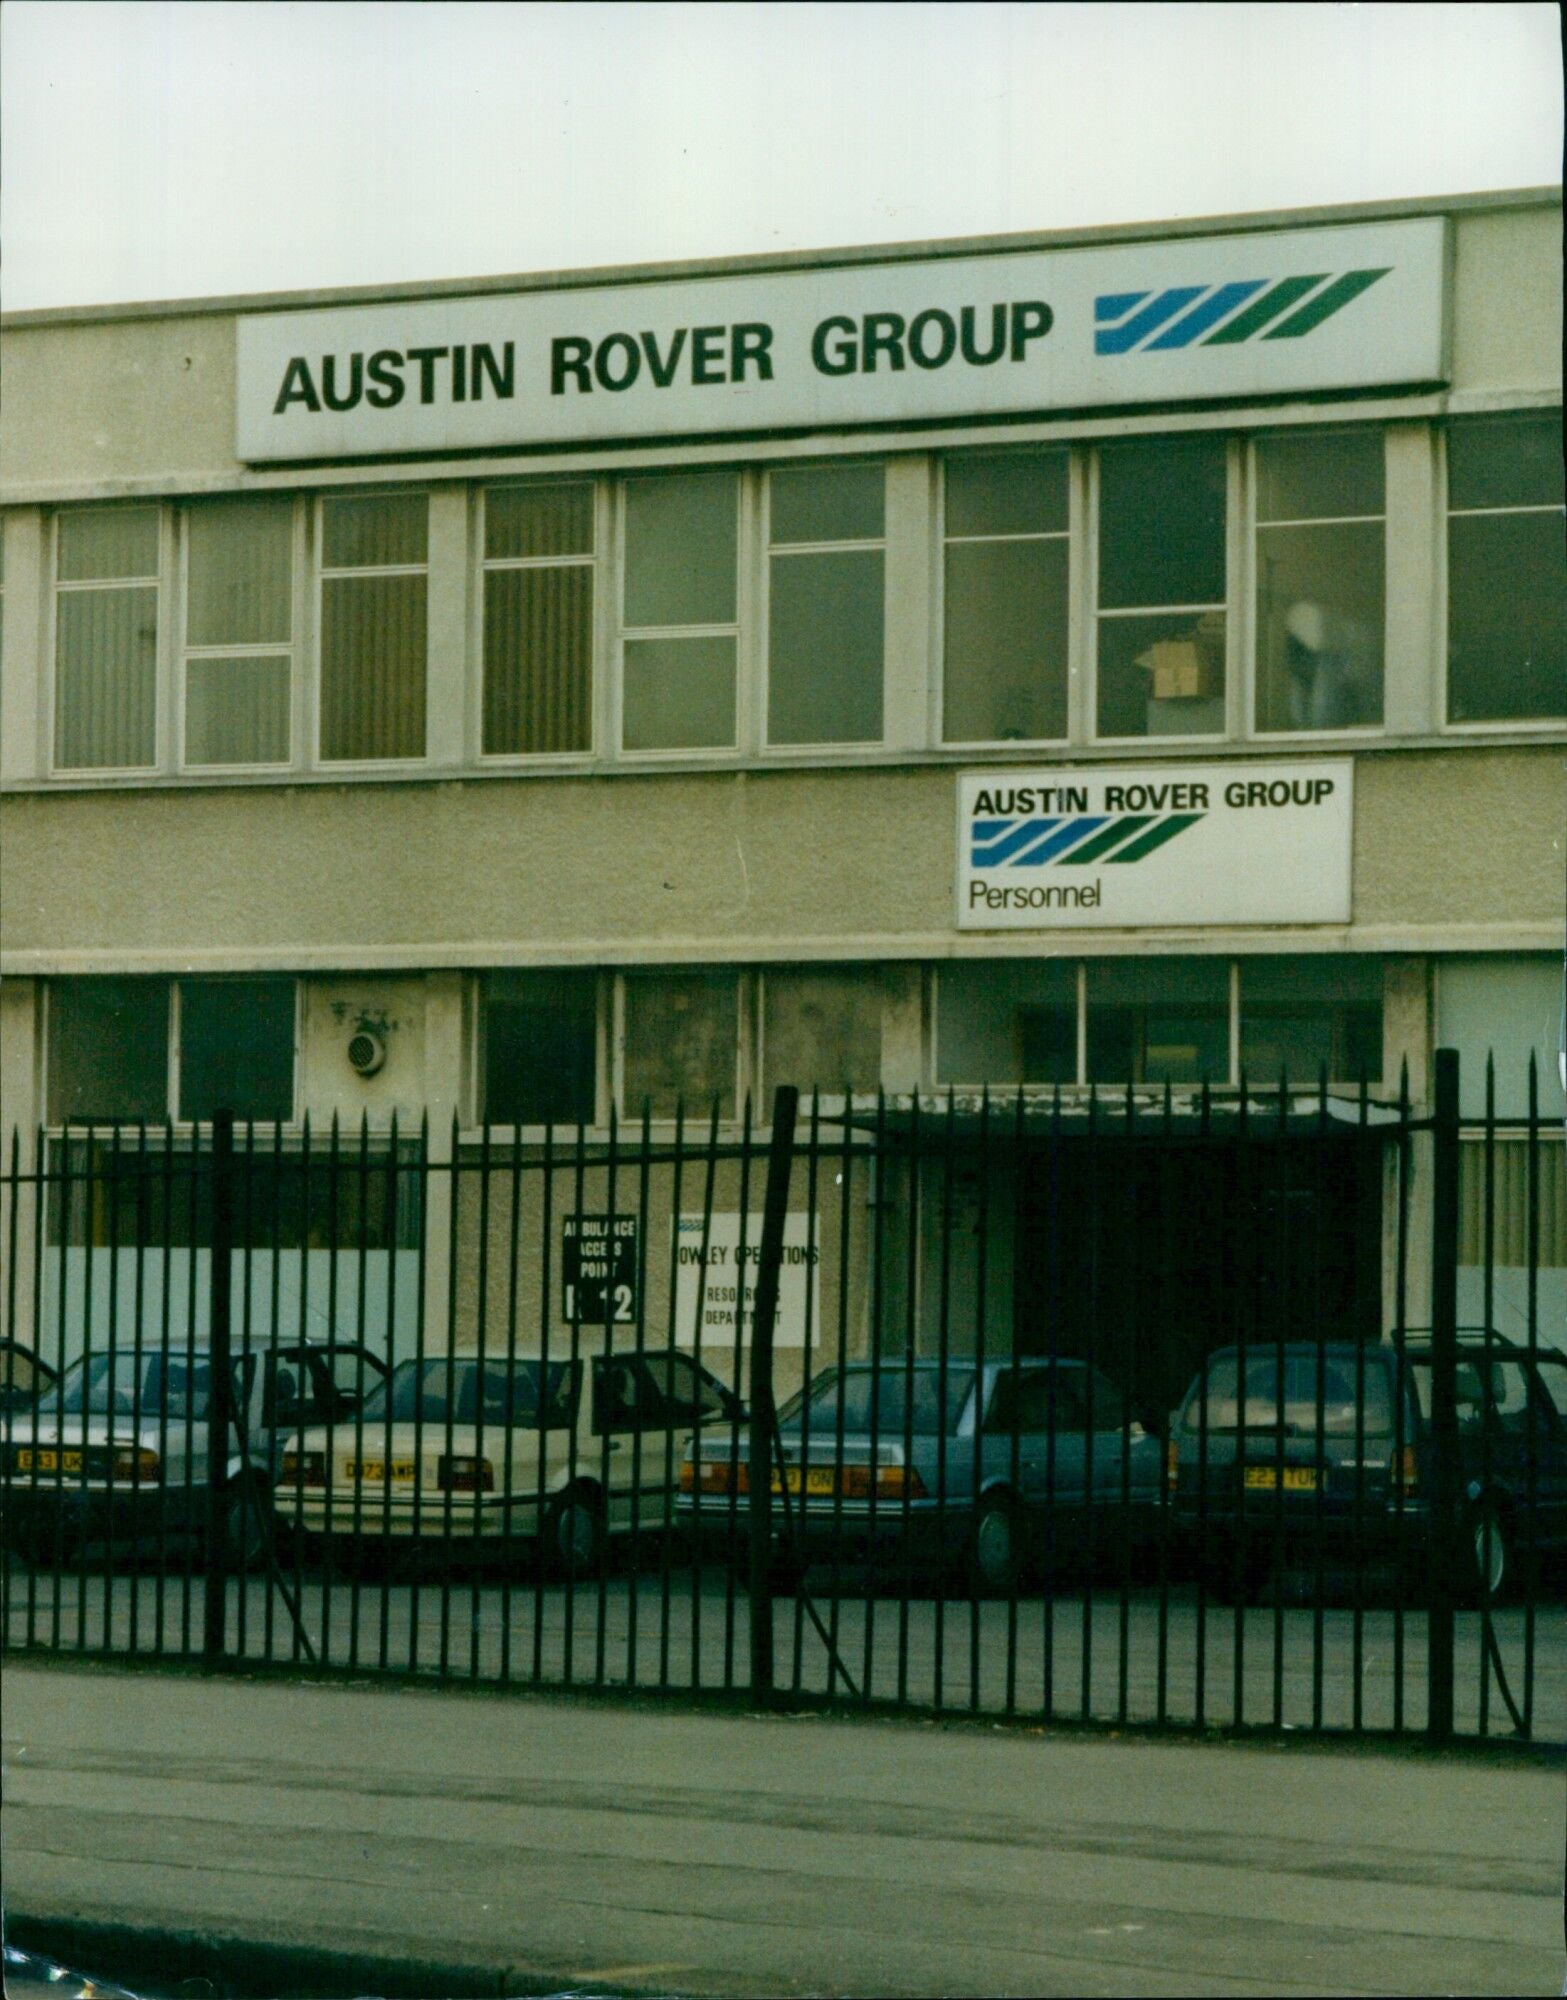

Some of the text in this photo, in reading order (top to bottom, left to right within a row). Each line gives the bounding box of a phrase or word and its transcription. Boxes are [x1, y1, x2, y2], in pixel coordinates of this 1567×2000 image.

[273, 300, 1053, 415] AUSTIN ROVER GROUP
[973, 779, 1334, 815] AUSTIN ROVER GROUP
[970, 879, 1101, 909] Personnel
